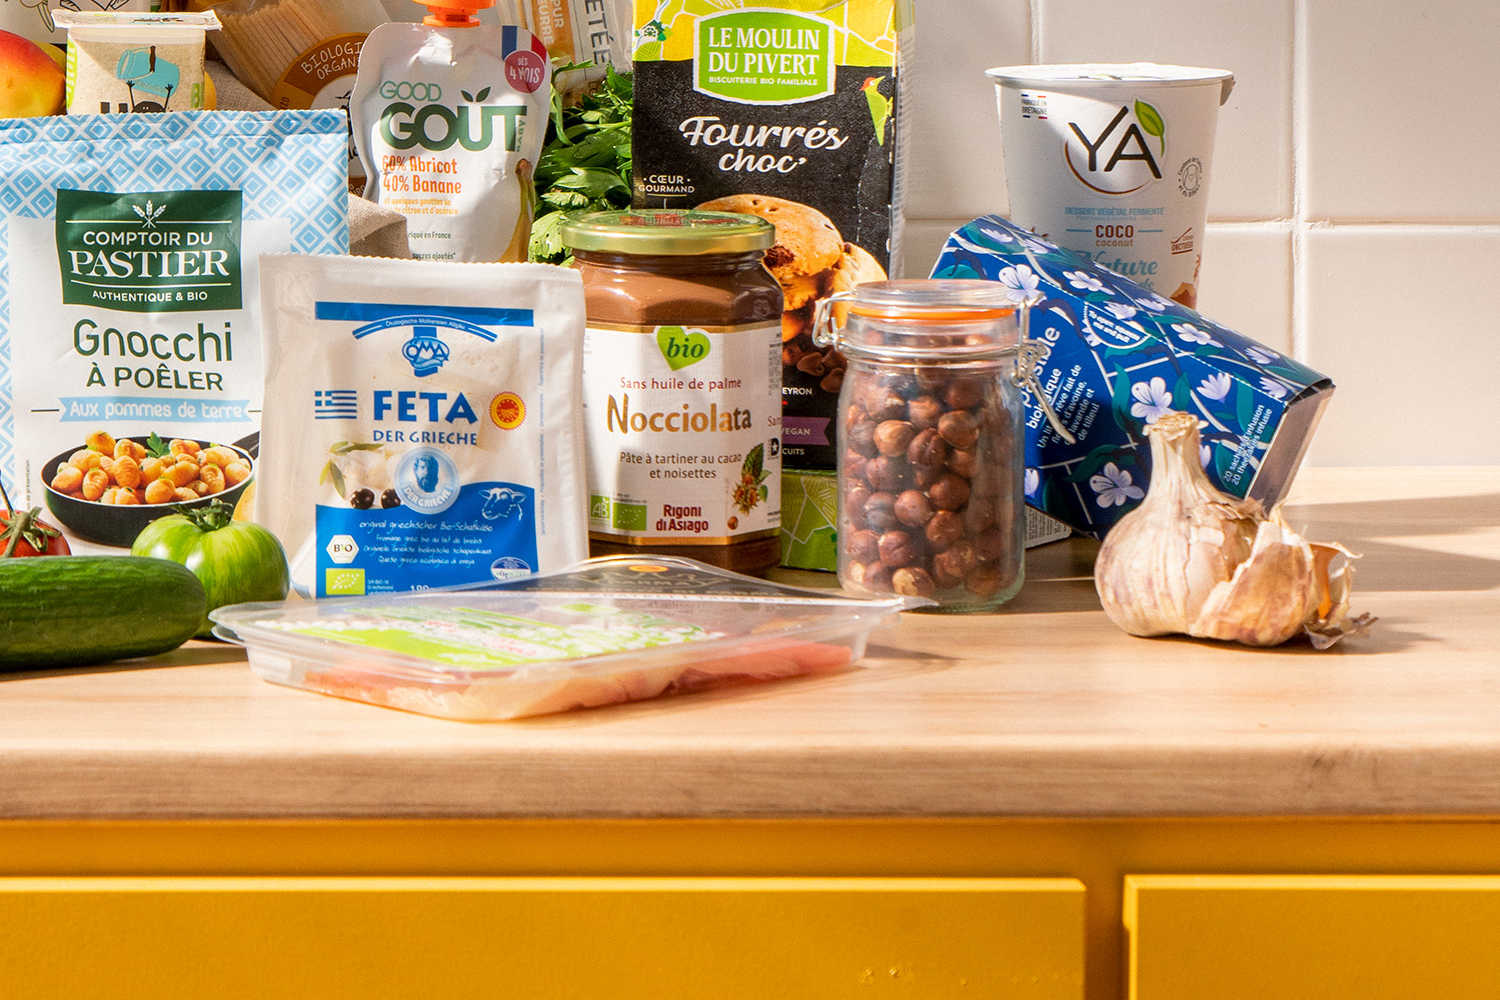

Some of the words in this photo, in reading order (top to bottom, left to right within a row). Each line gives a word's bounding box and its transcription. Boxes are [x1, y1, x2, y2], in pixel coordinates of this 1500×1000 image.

[708, 27, 733, 48] LE
[735, 27, 821, 50] MOULIN
[300, 41, 363, 74] BIOLOGI
[707, 51, 740, 74] DU
[743, 52, 820, 76] PIVERT
[509, 66, 517, 79] 4
[518, 67, 540, 83] MOIS
[708, 76, 758, 85] BISCUITERIE
[760, 77, 774, 85] BIO
[776, 77, 819, 86] FAMILIALE
[379, 80, 442, 101] GOOD
[1021, 106, 1048, 115] BRETAGNE
[516, 119, 527, 153] BABY
[678, 115, 850, 151] Fourrés
[1067, 105, 1163, 180] YA
[382, 154, 407, 173] 60%
[409, 154, 458, 175] Abricot
[383, 174, 410, 192] 40%
[412, 174, 462, 194] Banane
[638, 184, 695, 195] GOURMAND
[401, 205, 421, 215] citron
[1064, 206, 1095, 216] DESSERT
[82, 231, 182, 247] COMPTOIR
[186, 230, 213, 245] DU
[431, 231, 452, 239] France
[1095, 225, 1134, 239] COCO
[1095, 239, 1134, 248] coconut
[67, 250, 230, 278] PASTIER
[92, 290, 172, 302] AUTHENTIQUE
[175, 290, 183, 301] &
[186, 290, 208, 301] BIO
[73, 318, 233, 362] Gnocchi
[666, 337, 704, 358] bio
[86, 362, 106, 388] À
[114, 363, 224, 391] POÊLER
[620, 377, 647, 390] Sans
[651, 377, 684, 390] huile
[688, 377, 704, 390] de
[708, 377, 742, 392] palme
[1055, 393, 1069, 413] rêve
[1070, 364, 1082, 377] de
[69, 402, 98, 417] Aux
[105, 402, 172, 420] pommes
[177, 402, 196, 418] de
[201, 403, 243, 419] terre
[373, 390, 479, 425] FETA
[606, 392, 752, 435] Nocciolata
[1068, 398, 1090, 434] lavande
[1083, 402, 1101, 429] tilleul
[373, 429, 404, 443] DER
[408, 430, 478, 446] GRIECHE
[619, 451, 643, 465] Pâte
[645, 452, 652, 465] à
[655, 453, 698, 465] tartiner
[701, 455, 715, 465] au
[717, 452, 742, 465] cacao
[649, 468, 661, 479] et
[664, 468, 717, 479] noisettes
[591, 503, 608, 518] AB
[663, 504, 702, 519] Rigoni
[359, 519, 387, 535] original
[387, 520, 437, 535] griechischer
[655, 518, 667, 531] di
[668, 518, 709, 533] Asiago
